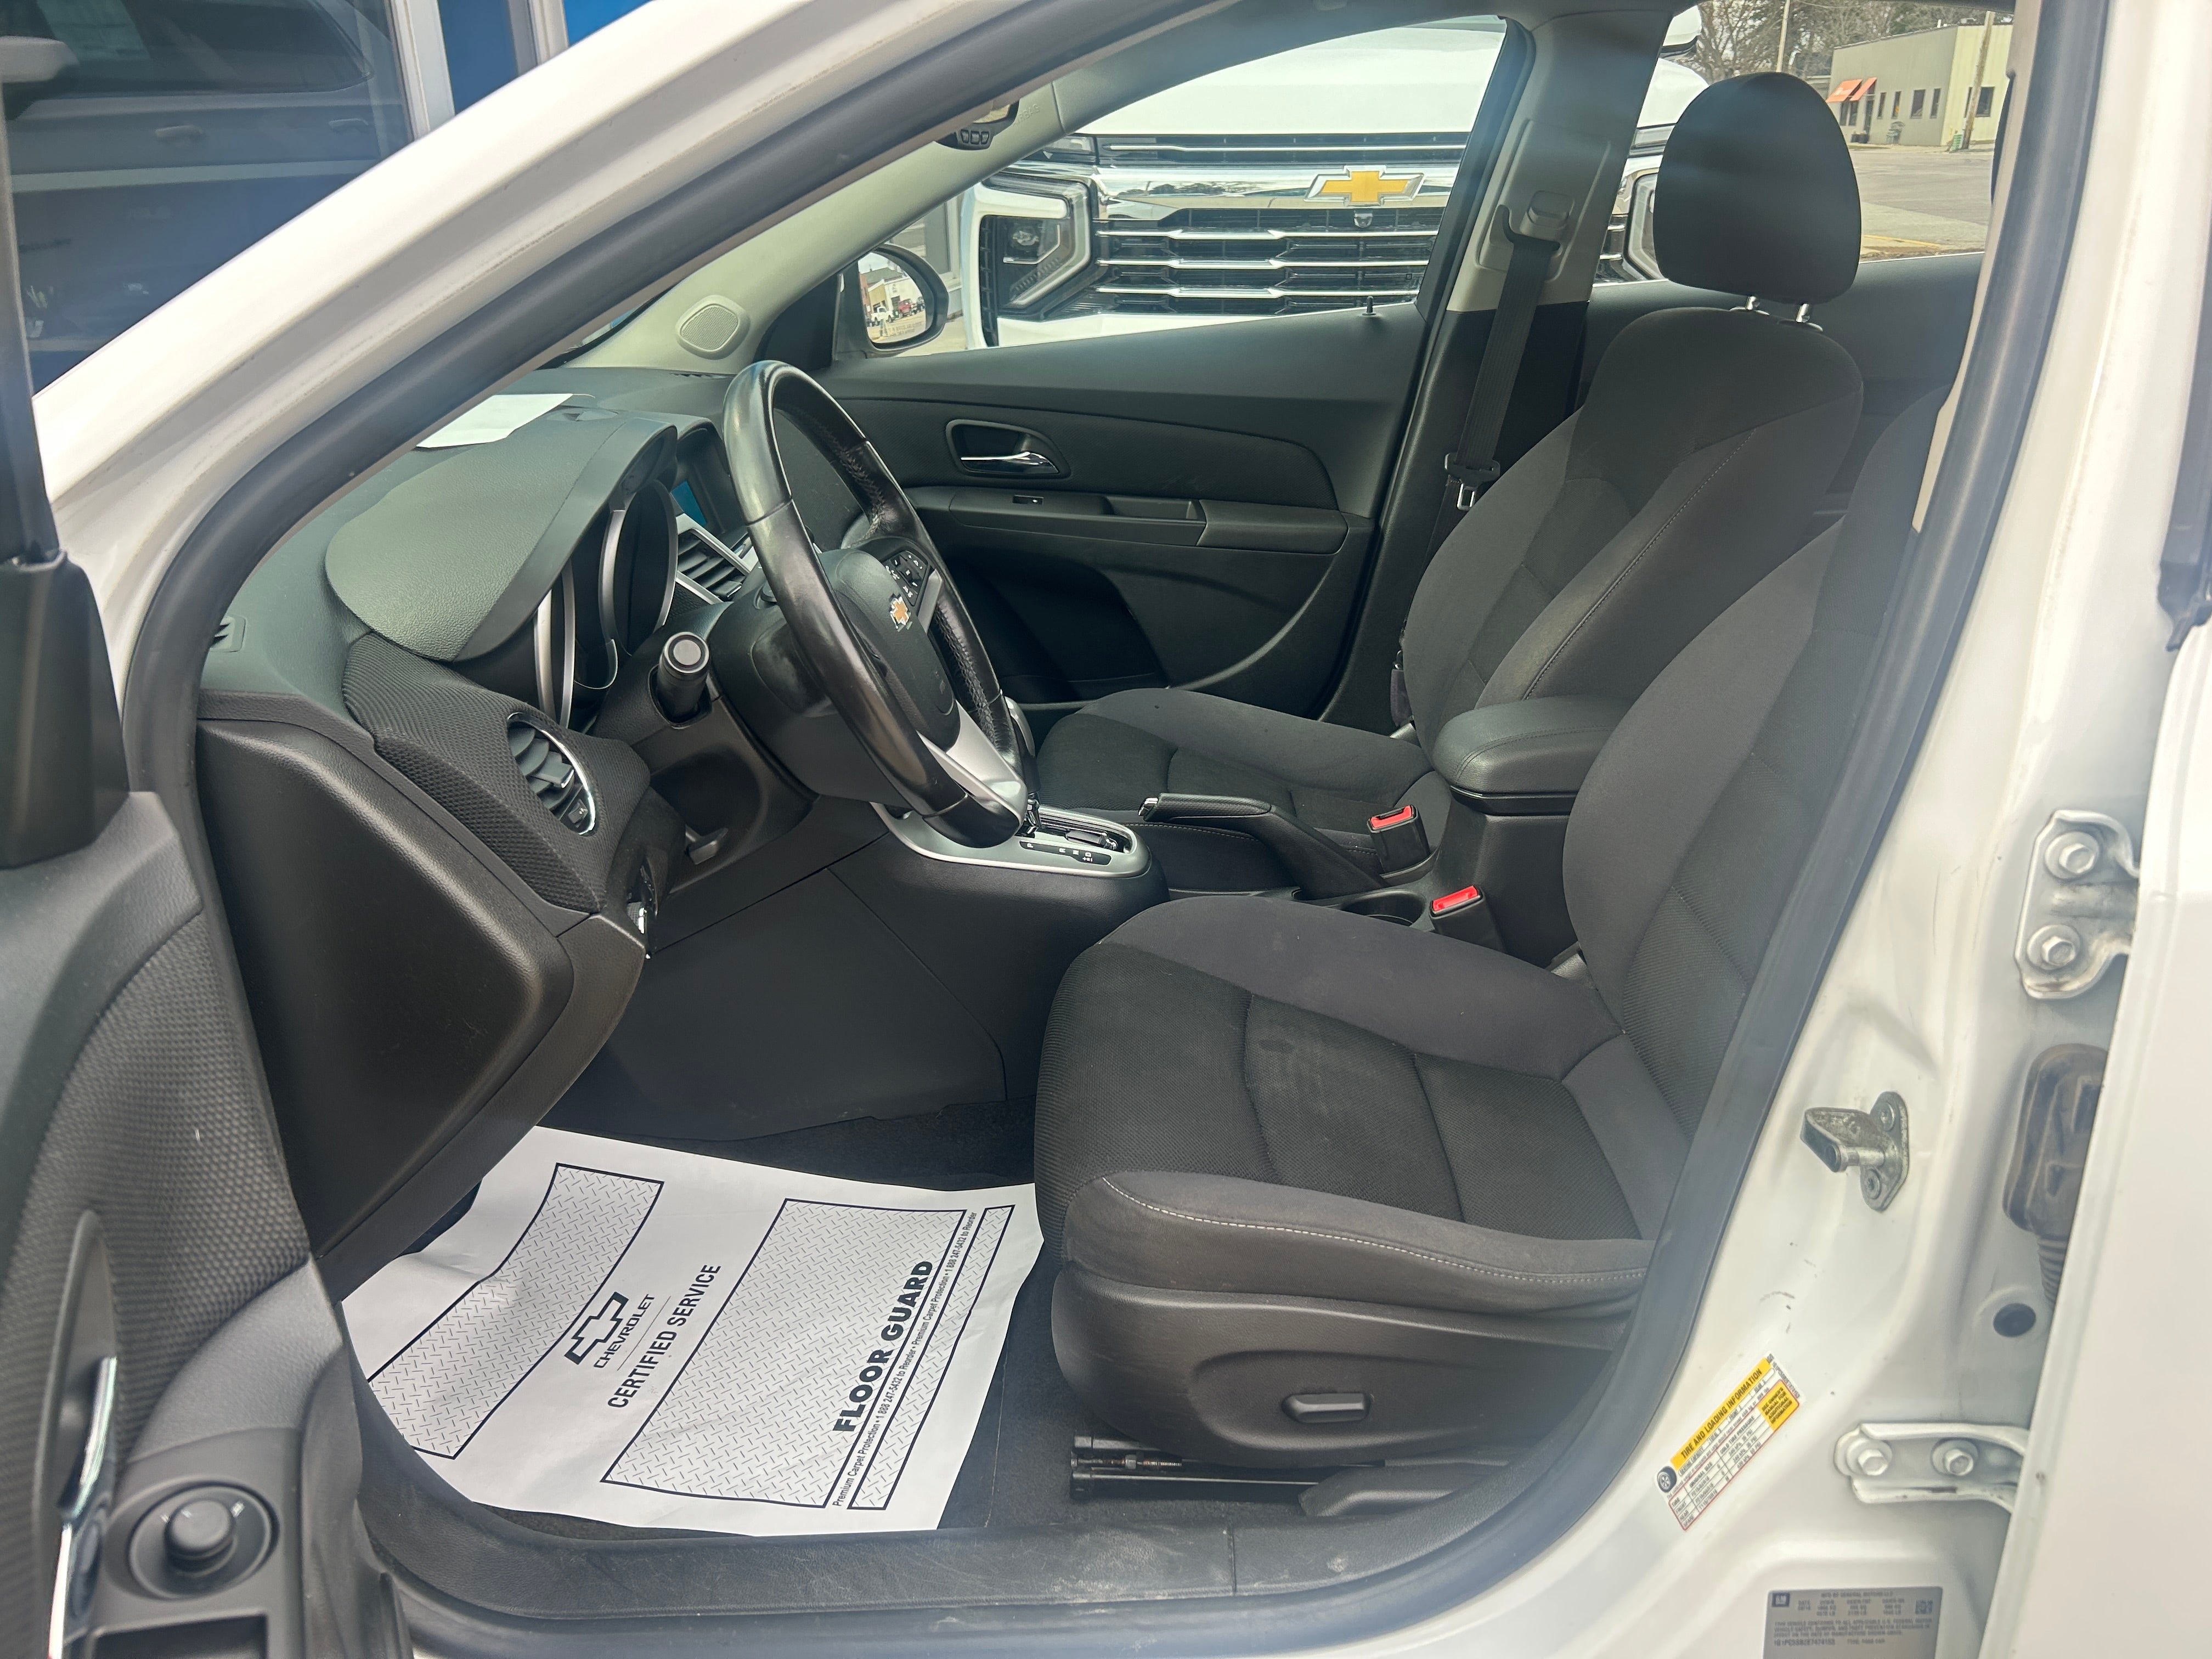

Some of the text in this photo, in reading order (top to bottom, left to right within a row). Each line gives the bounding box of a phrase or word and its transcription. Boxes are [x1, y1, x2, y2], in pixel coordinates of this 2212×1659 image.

[963, 1212, 977, 1232] Reorder
[950, 1237, 967, 1259] 247-5432
[947, 1257, 959, 1268] 888
[933, 1276, 950, 1302] Protection
[923, 1300, 940, 1321] Carpet
[593, 1294, 655, 1368] CHEVROLET
[607, 1264, 721, 1408] CERTIFIED SERVICE
[912, 1322, 930, 1346] Premium
[833, 1261, 933, 1432] FLOOR GUARD
[899, 1350, 917, 1371] Reorder
[896, 1369, 906, 1378] to
[884, 1378, 902, 1404] 247-5432
[878, 1403, 890, 1415] 888
[1680, 1368, 1762, 1458] TIRE AND LOADING INFORMATION
[862, 1423, 881, 1454] Protection
[848, 1452, 866, 1476] Carpet
[832, 1477, 854, 1506] Premium
